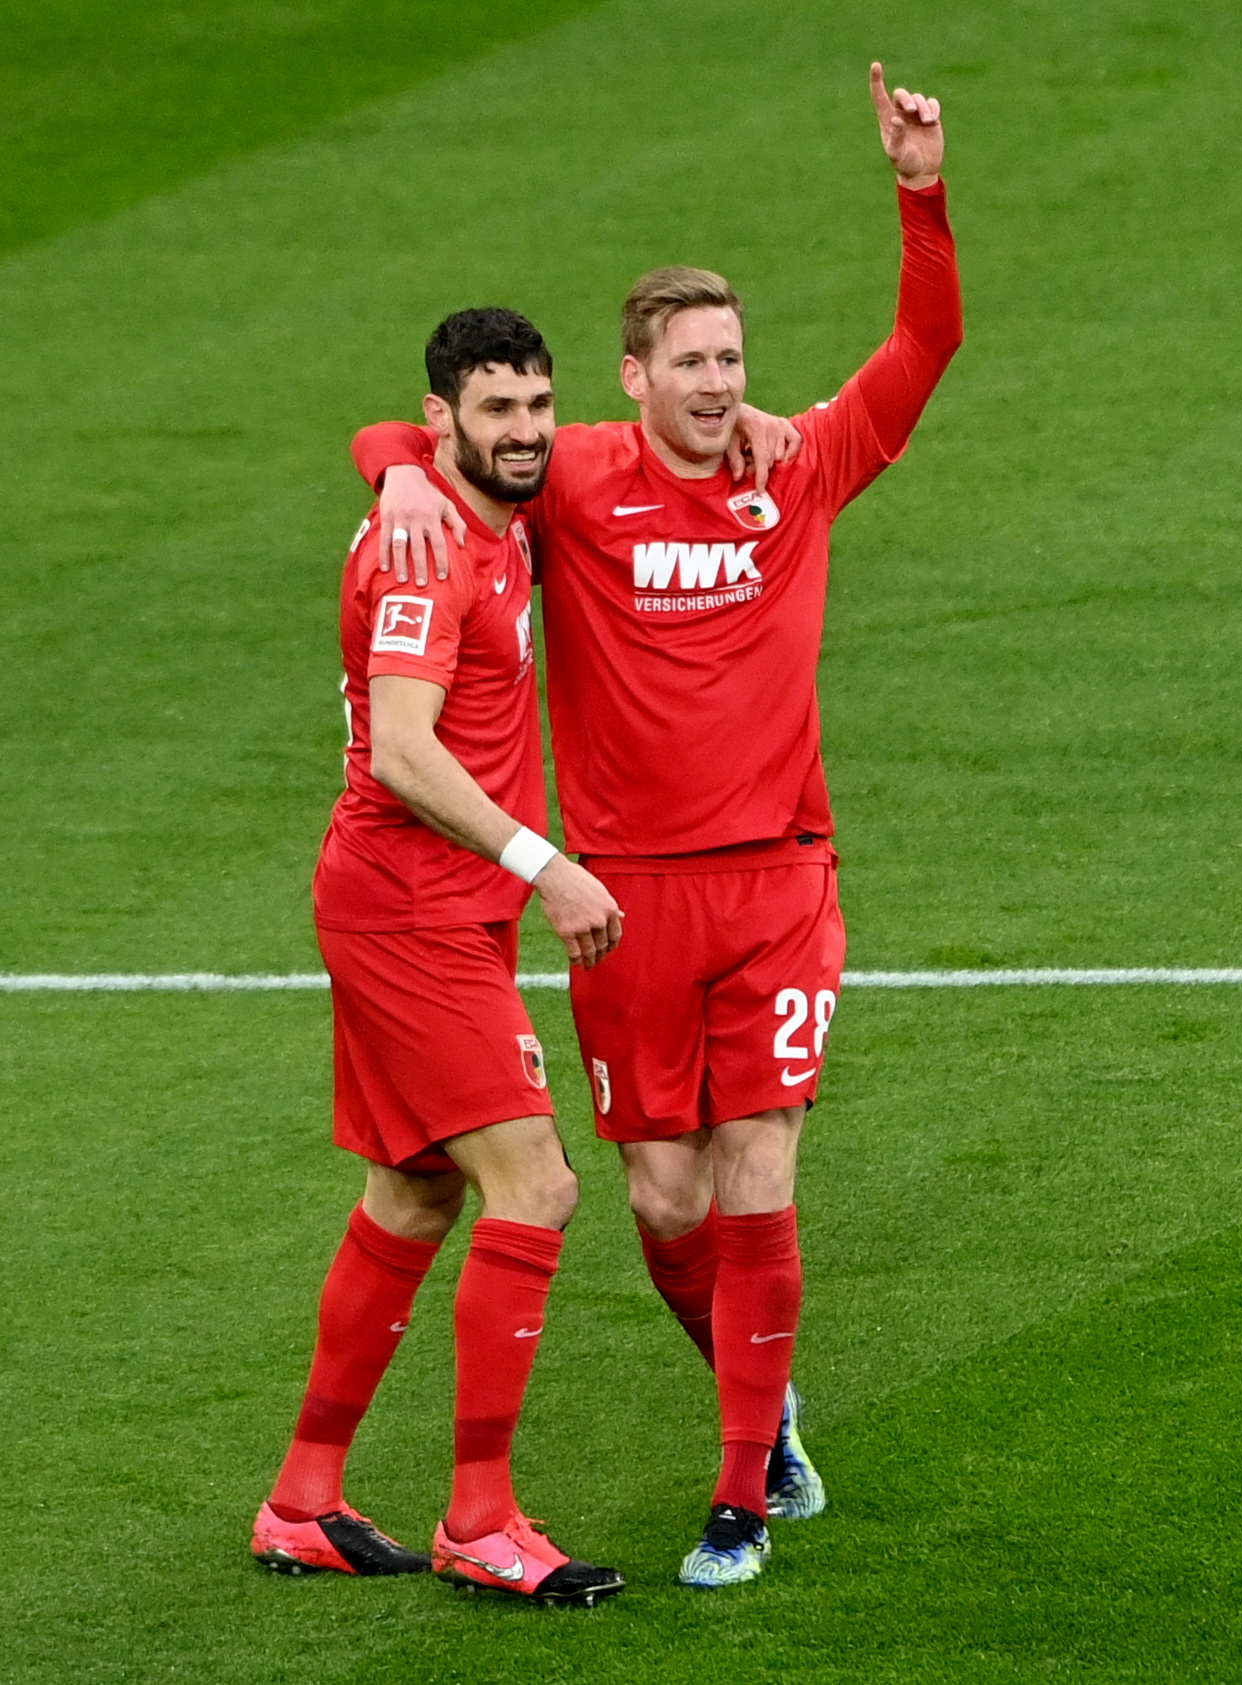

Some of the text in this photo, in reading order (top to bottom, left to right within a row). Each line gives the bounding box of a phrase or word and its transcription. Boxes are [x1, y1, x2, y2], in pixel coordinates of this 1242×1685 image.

[633, 541, 763, 590] WWK
[634, 586, 764, 612] VERSICHERUNGEN
[773, 988, 837, 1059] 28
